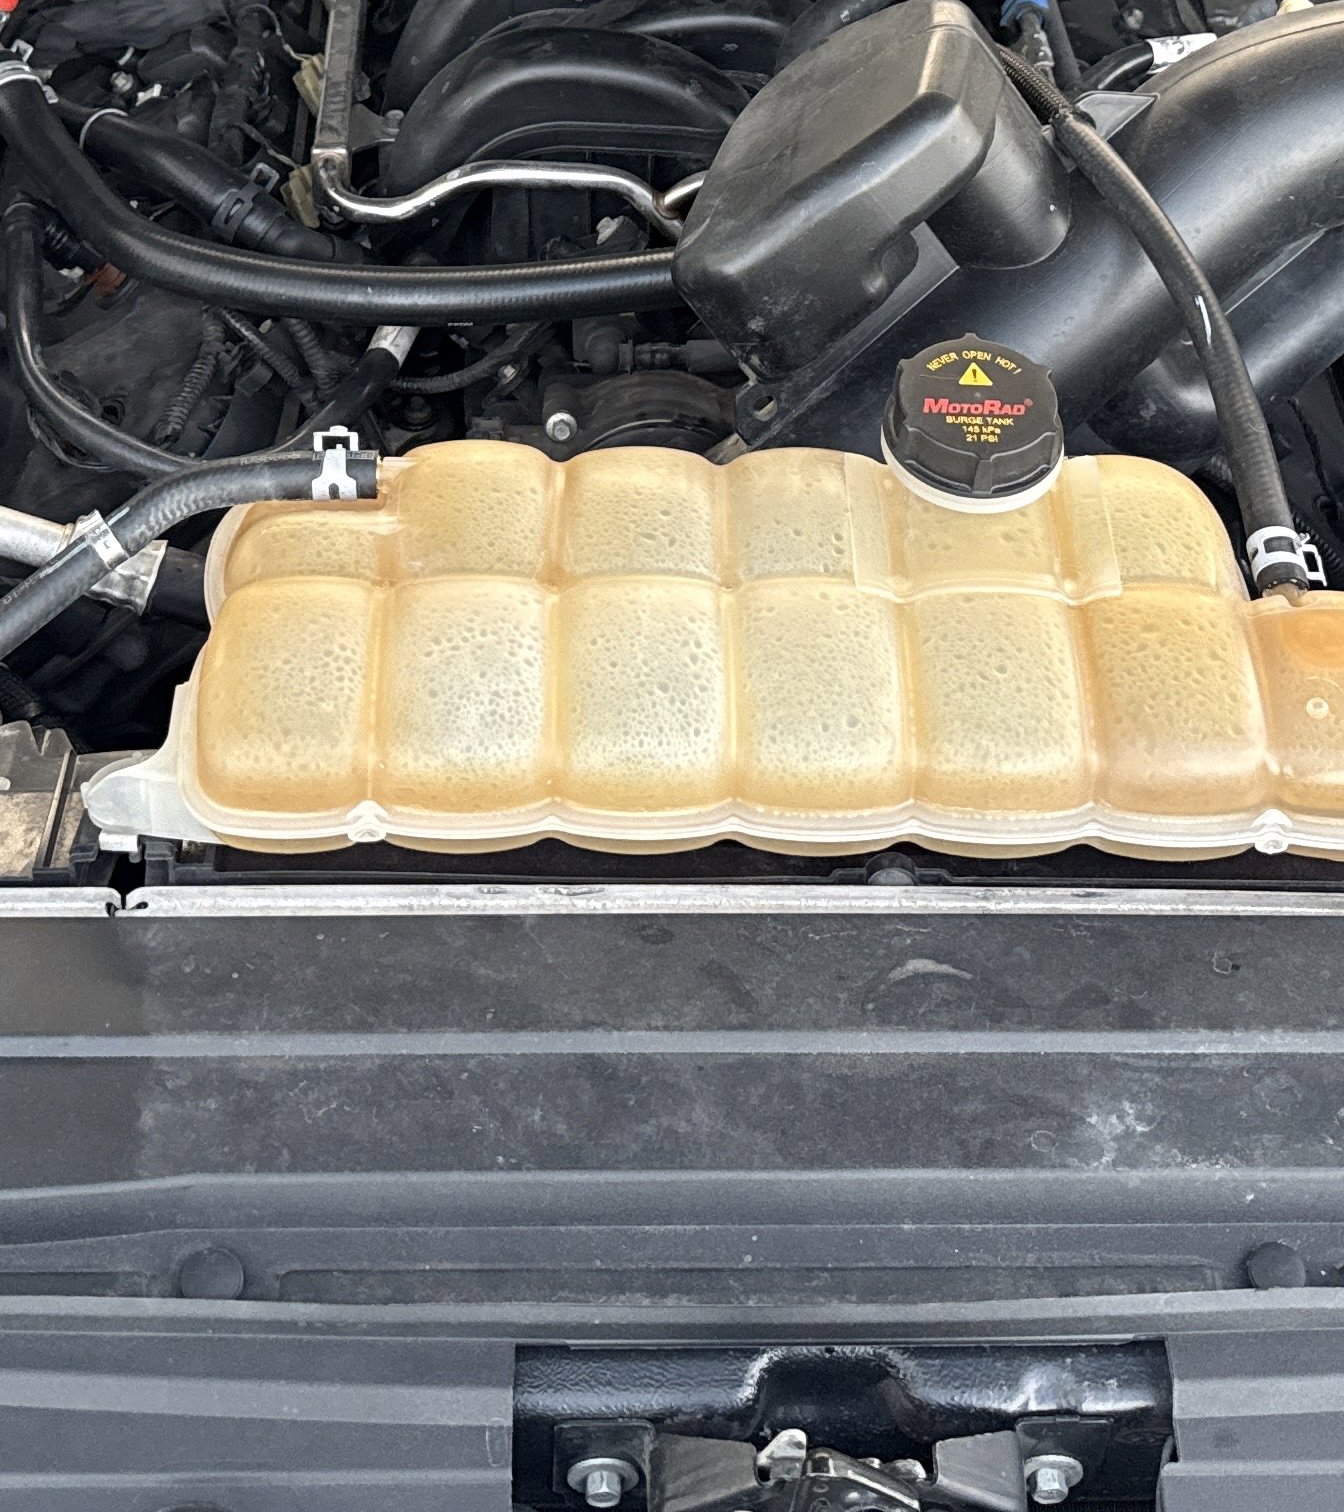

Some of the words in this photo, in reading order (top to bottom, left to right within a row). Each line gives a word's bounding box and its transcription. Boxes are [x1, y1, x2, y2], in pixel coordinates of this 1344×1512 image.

[926, 352, 959, 372] NEVER
[962, 350, 992, 361] OPEN
[945, 415, 984, 425] SURGE
[986, 416, 1014, 426] TANK
[980, 434, 999, 444] PSI
